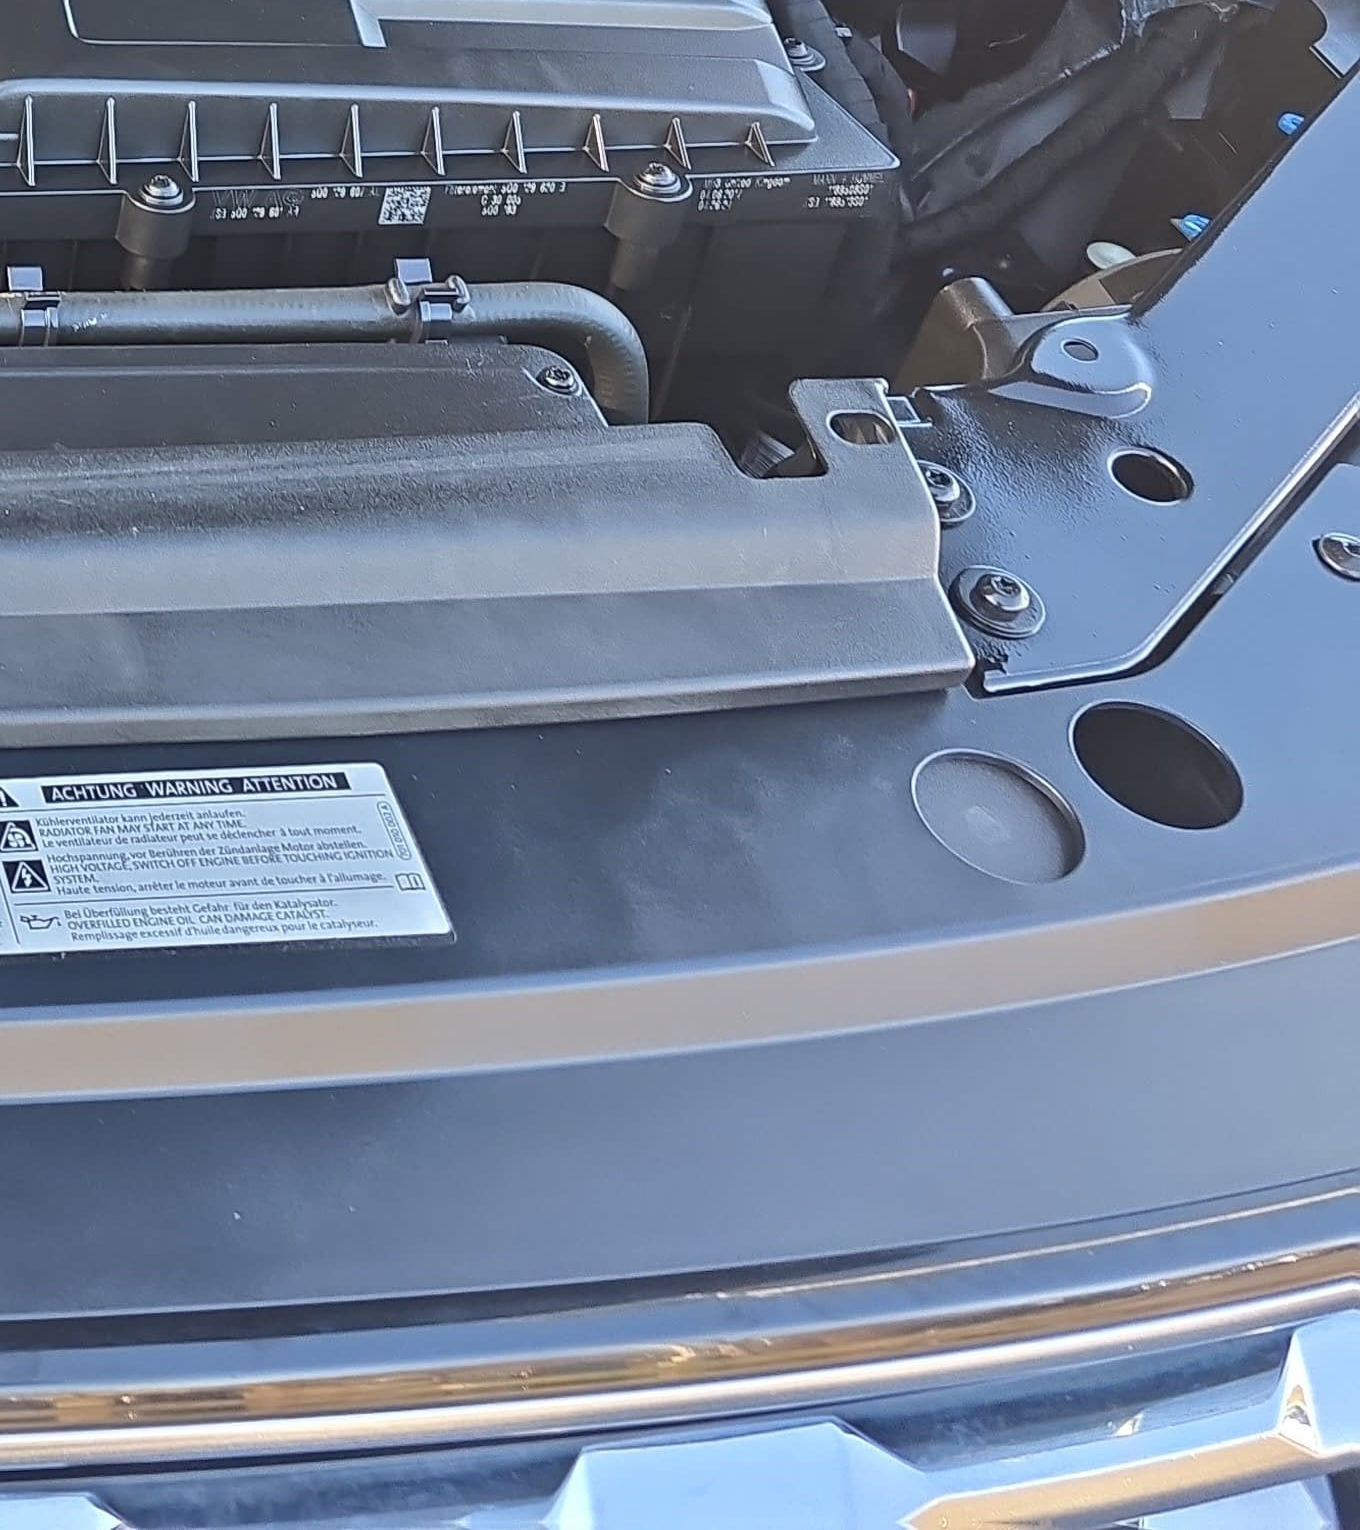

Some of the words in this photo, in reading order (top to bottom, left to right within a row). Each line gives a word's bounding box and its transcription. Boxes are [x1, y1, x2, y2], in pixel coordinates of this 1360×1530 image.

[51, 784, 137, 802] ACHTUNG
[145, 779, 233, 797] WARNING
[242, 774, 338, 792] ATTENTION
[35, 814, 119, 827] Kühlerventilator
[120, 814, 147, 825] kann
[196, 809, 246, 821] anlaufen.
[38, 825, 92, 837] RADIATOR
[93, 824, 116, 835] FAN
[116, 823, 142, 834] MAY
[142, 822, 175, 833] START
[177, 821, 192, 831] AT
[193, 820, 216, 830] ANY
[55, 835, 113, 847] ventilateur
[114, 835, 128, 845] de
[129, 833, 178, 844] radiateur
[180, 832, 205, 845] peut
[279, 827, 287, 837] à
[288, 827, 312, 837] tout
[314, 825, 362, 836] moment.
[131, 850, 147, 860] vor
[148, 847, 197, 860] Berühren
[198, 846, 217, 856] der
[217, 843, 280, 857] Zündanlage
[281, 843, 315, 854] Motor
[316, 840, 368, 852] abstellen.
[50, 864, 80, 875] HIGH
[134, 860, 175, 872] SWITCH
[176, 859, 198, 870] OFF
[199, 856, 240, 868] ENGINE
[241, 855, 282, 866] BEFORE
[283, 852, 341, 864] TOUCHING
[342, 848, 394, 861] IGNITION
[53, 873, 99, 885] SYSTEM.
[56, 885, 90, 896] Haute
[137, 881, 174, 892] arrêter
[174, 881, 186, 891] le
[188, 879, 226, 890] moteur
[228, 878, 257, 889] avant
[258, 876, 275, 887] de
[276, 874, 317, 886] toucher
[318, 873, 326, 884] à
[64, 909, 82, 920] Bei
[149, 905, 190, 916] besteht
[191, 902, 229, 914] Gefahr
[234, 900, 250, 912] für
[252, 900, 273, 911] den
[67, 918, 131, 931] OVERFILLED
[133, 917, 174, 929] ENGINE
[176, 916, 195, 927] OIL
[198, 914, 224, 925] CAN
[225, 911, 274, 924] DAMAGE
[71, 929, 138, 943] Remplissage
[139, 927, 183, 938] excessif
[222, 923, 281, 937] dangereux
[282, 922, 307, 935] pour
[307, 921, 319, 932] le
